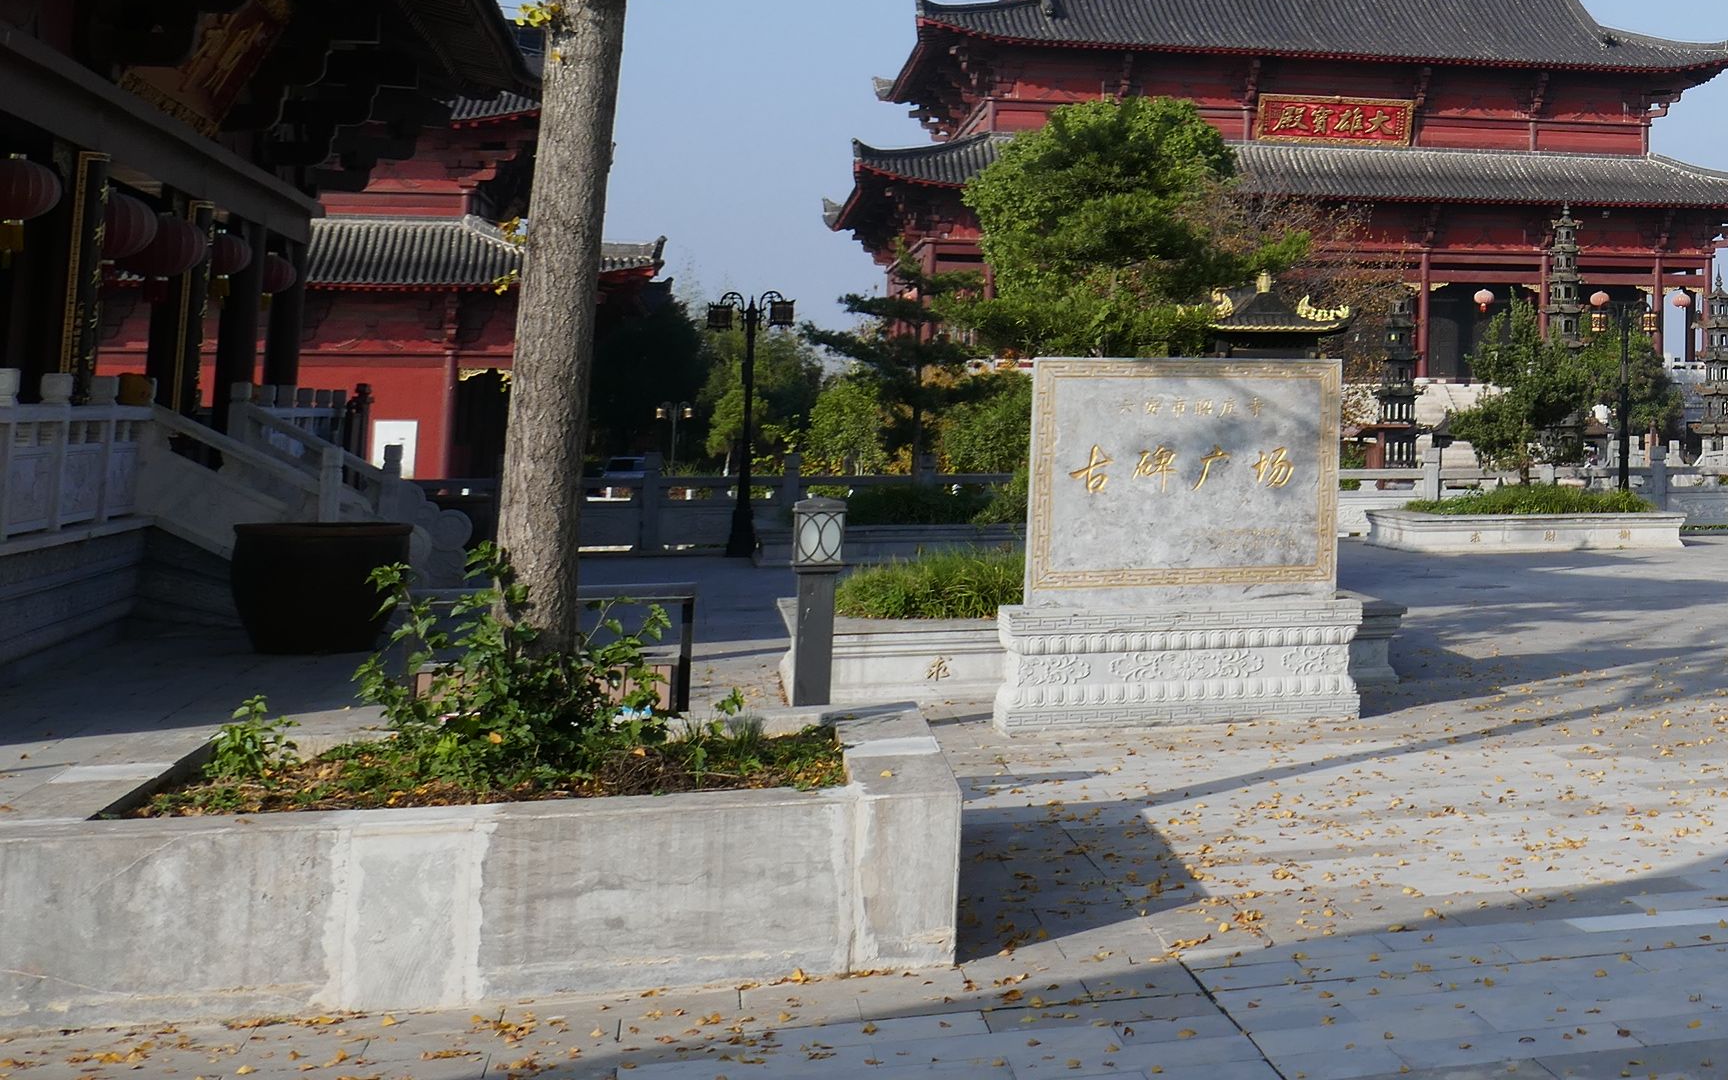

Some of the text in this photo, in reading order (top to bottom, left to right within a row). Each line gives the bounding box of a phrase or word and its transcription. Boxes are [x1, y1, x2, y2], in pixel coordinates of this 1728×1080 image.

[1272, 106, 1395, 134] 大雄寶殿
[1117, 396, 1265, 419] 六安市昭庆寺
[1068, 444, 1296, 494] 古碑广场
[926, 656, 953, 682] 求
